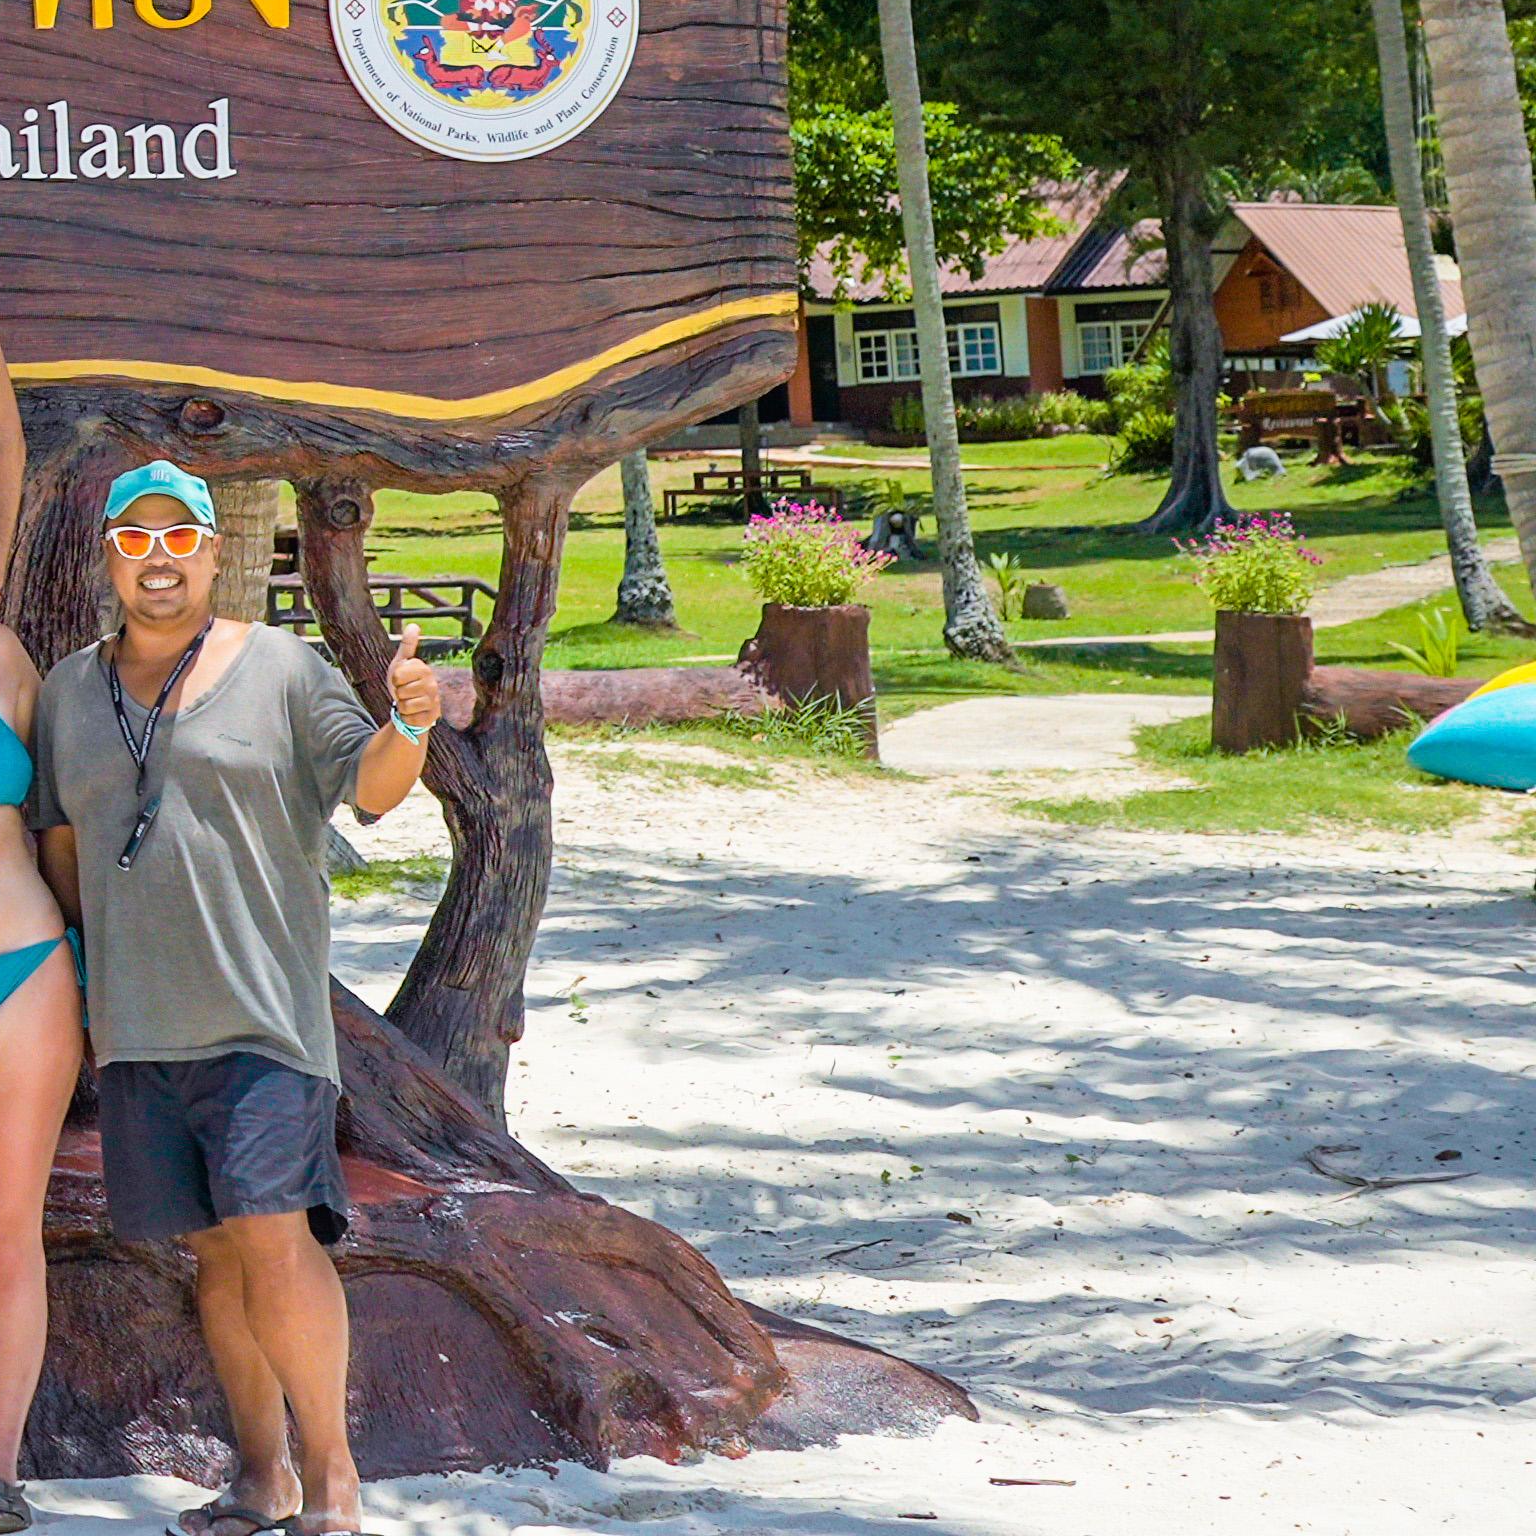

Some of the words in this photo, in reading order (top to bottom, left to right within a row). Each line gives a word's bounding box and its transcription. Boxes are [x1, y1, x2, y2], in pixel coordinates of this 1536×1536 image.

[352, 28, 386, 90] Department
[386, 91, 401, 103] of
[400, 101, 442, 133] National
[448, 127, 480, 144] Parks,
[487, 130, 529, 144] Wildlife
[534, 120, 555, 135] and
[556, 101, 583, 124] Plant
[582, 36, 619, 100] Conservation
